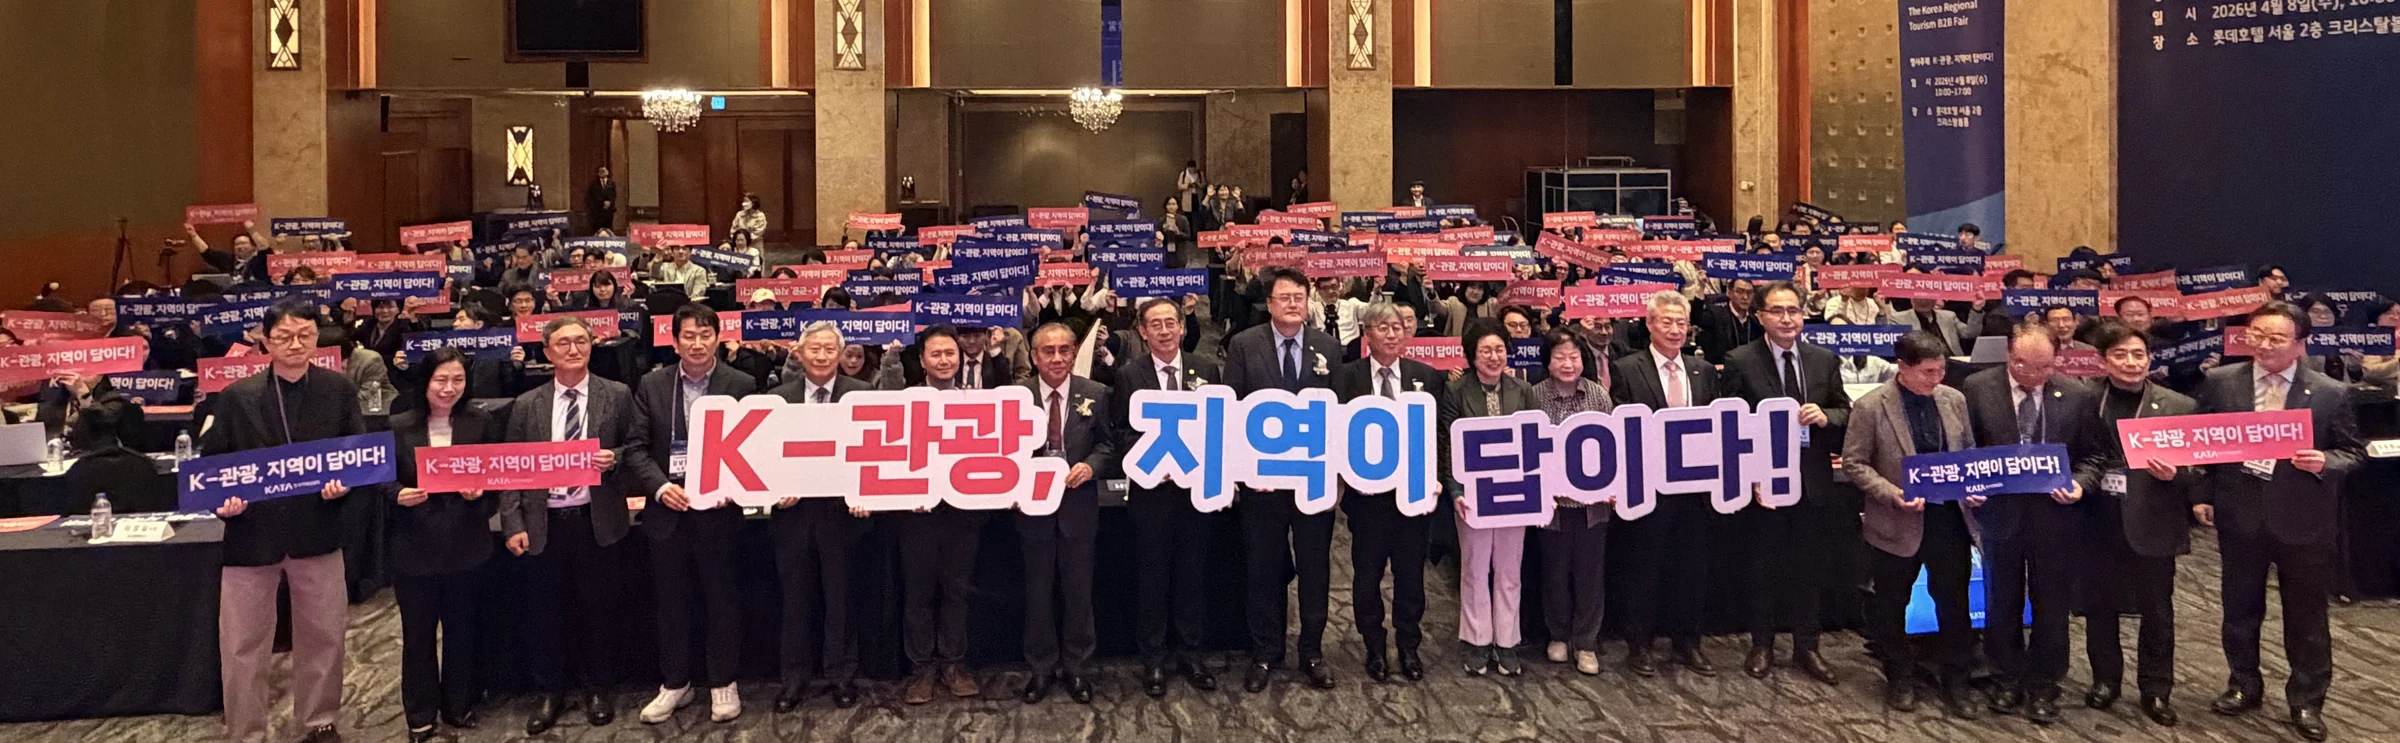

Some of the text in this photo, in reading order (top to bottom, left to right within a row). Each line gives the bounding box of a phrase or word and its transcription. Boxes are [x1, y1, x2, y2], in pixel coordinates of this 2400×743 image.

[1908, 0, 1978, 16] The Korea Regional
[2152, 10, 2163, 26] 일
[2185, 6, 2197, 21] 시
[2212, 1, 2257, 19] 2026년
[1908, 15, 1969, 31] Tourism B2B Fair
[2153, 35, 2165, 51] 장
[2186, 32, 2199, 46] 소
[2213, 26, 2264, 46] 롯데호텔
[2268, 23, 2295, 41] 서울
[2299, 20, 2323, 39] 2층
[955, 249, 1027, 257] K-관광, 지역이 답이다!
[1092, 253, 1162, 262] K-관광, 지역이 답이다!
[1430, 262, 1508, 271] K-관광, 지역이 답이다!
[1707, 259, 1792, 272] K-관광, 지역이 답이다!
[939, 265, 1029, 286] K-관광, 지역이 답이다!
[1117, 275, 1204, 287] K-관광, 지역이 답이다!
[336, 278, 434, 290] K-관광, 지역이 답이다!
[1882, 279, 1972, 291] K-관광, 지역이 답이다!
[1570, 294, 1638, 306] K-관광, 지역이
[2007, 296, 2094, 306] K-관광, 지역이 답이다!
[916, 302, 1017, 316] K-관광, 지역이 답이다!
[204, 310, 242, 324] K-관광,
[746, 318, 780, 329] K-관광,
[842, 320, 909, 332] 지역이 답이다!
[447, 337, 476, 347] 지역이
[478, 335, 511, 347] 답이다!
[1801, 332, 1839, 345] K-관광,
[1841, 333, 1871, 344] 지역이
[1, 346, 135, 367] K-관광, 지역이 답이다!
[1405, 346, 1463, 357] 지역이 답이다
[205, 365, 251, 378] K-관광,
[136, 378, 174, 389] 답이다!
[2128, 423, 2304, 450] K-관광, 지역이 답이다!
[425, 451, 593, 475] K-관광, 지역이 답이다!
[699, 397, 1790, 518] K-관광, 지역이 답이다!
[189, 446, 386, 492] K-관광, 지역이 답이다!
[1909, 456, 2060, 484] K-관광, 지역이 답이다!
[264, 483, 293, 495] KATA
